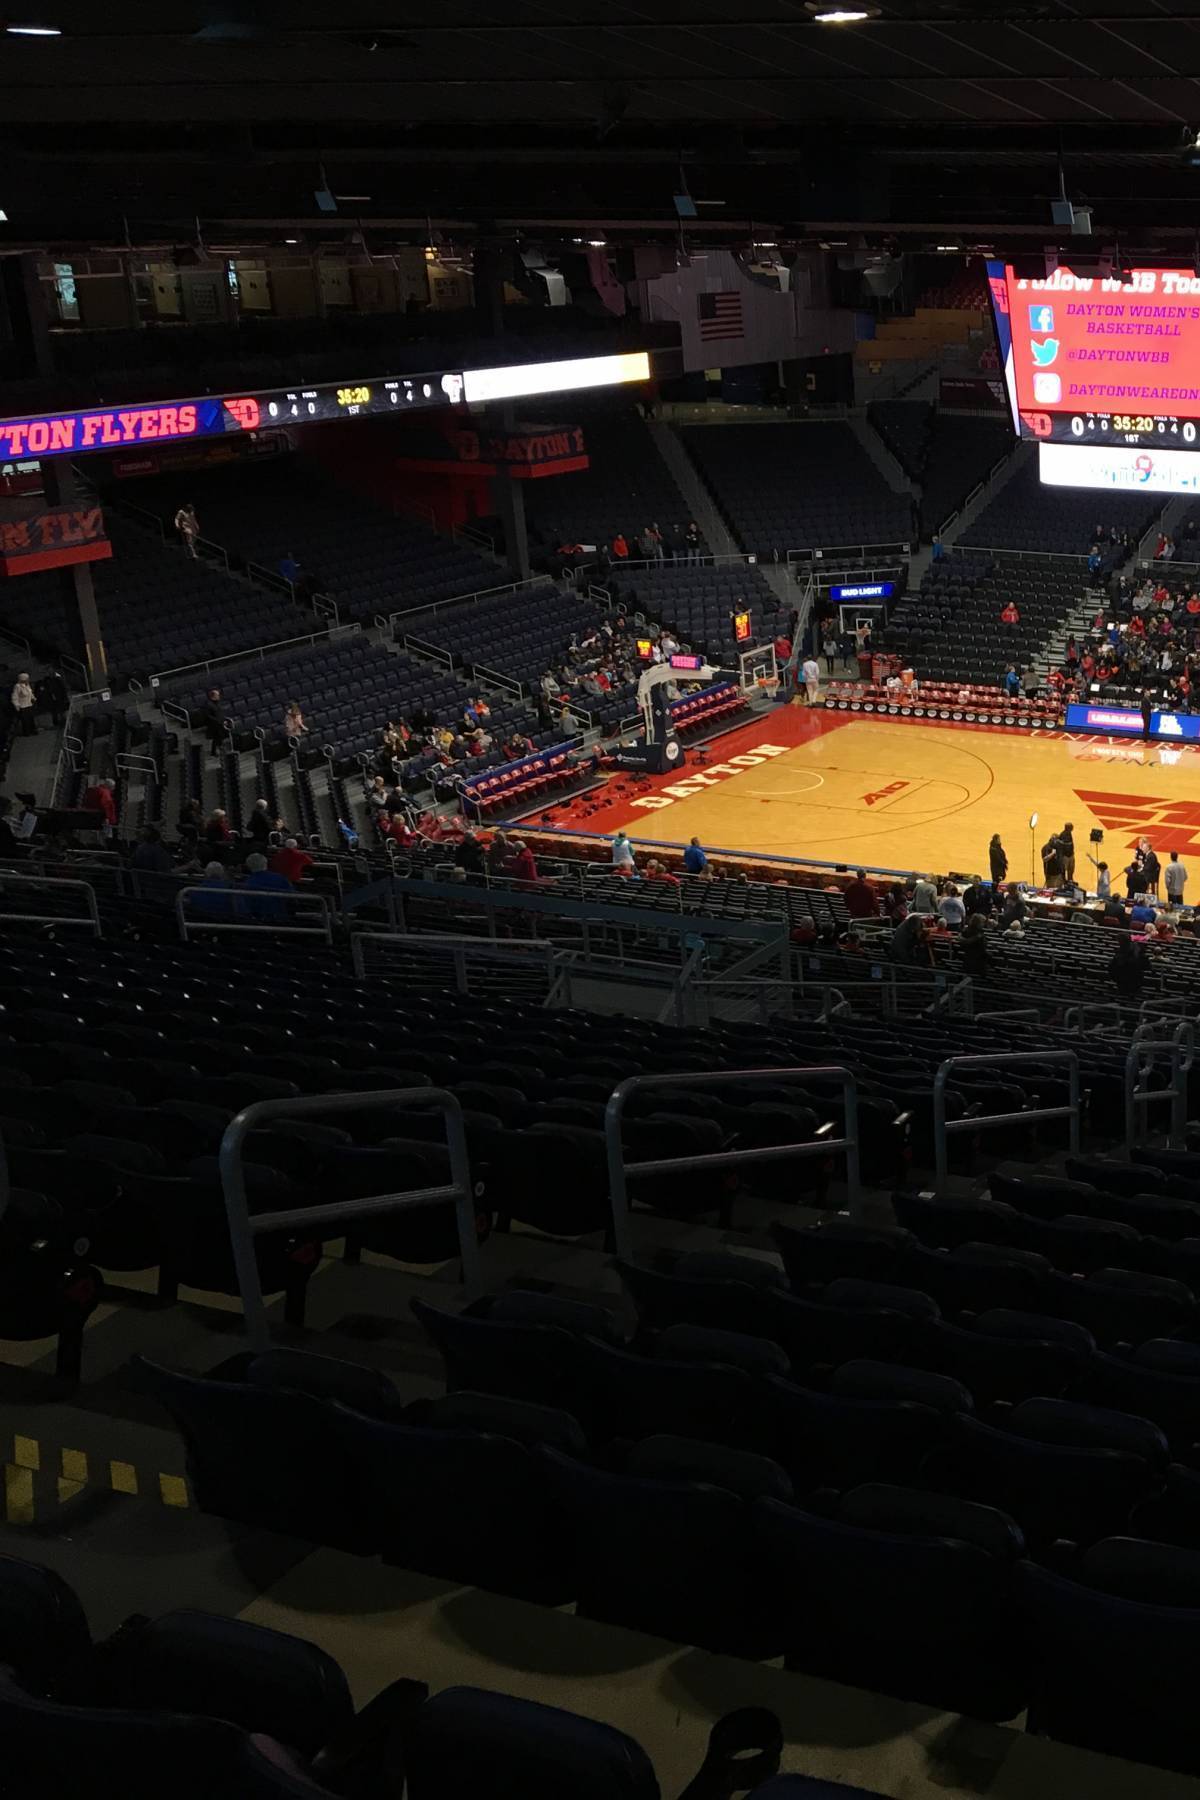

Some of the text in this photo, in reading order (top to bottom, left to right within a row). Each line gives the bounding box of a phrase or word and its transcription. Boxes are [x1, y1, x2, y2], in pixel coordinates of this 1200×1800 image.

[1066, 303, 1200, 319] DAYTON WOMEN'S
[1086, 321, 1182, 337] BASKETBALL
[1068, 348, 1170, 364] @DAYTONWBB
[337, 386, 370, 406] 35:20
[81, 405, 197, 446] FLYERS
[1071, 415, 1196, 442] 0 4 0 35:20 0 4 0
[859, 586, 883, 595] LIGHT
[629, 744, 791, 809] DAYTON
